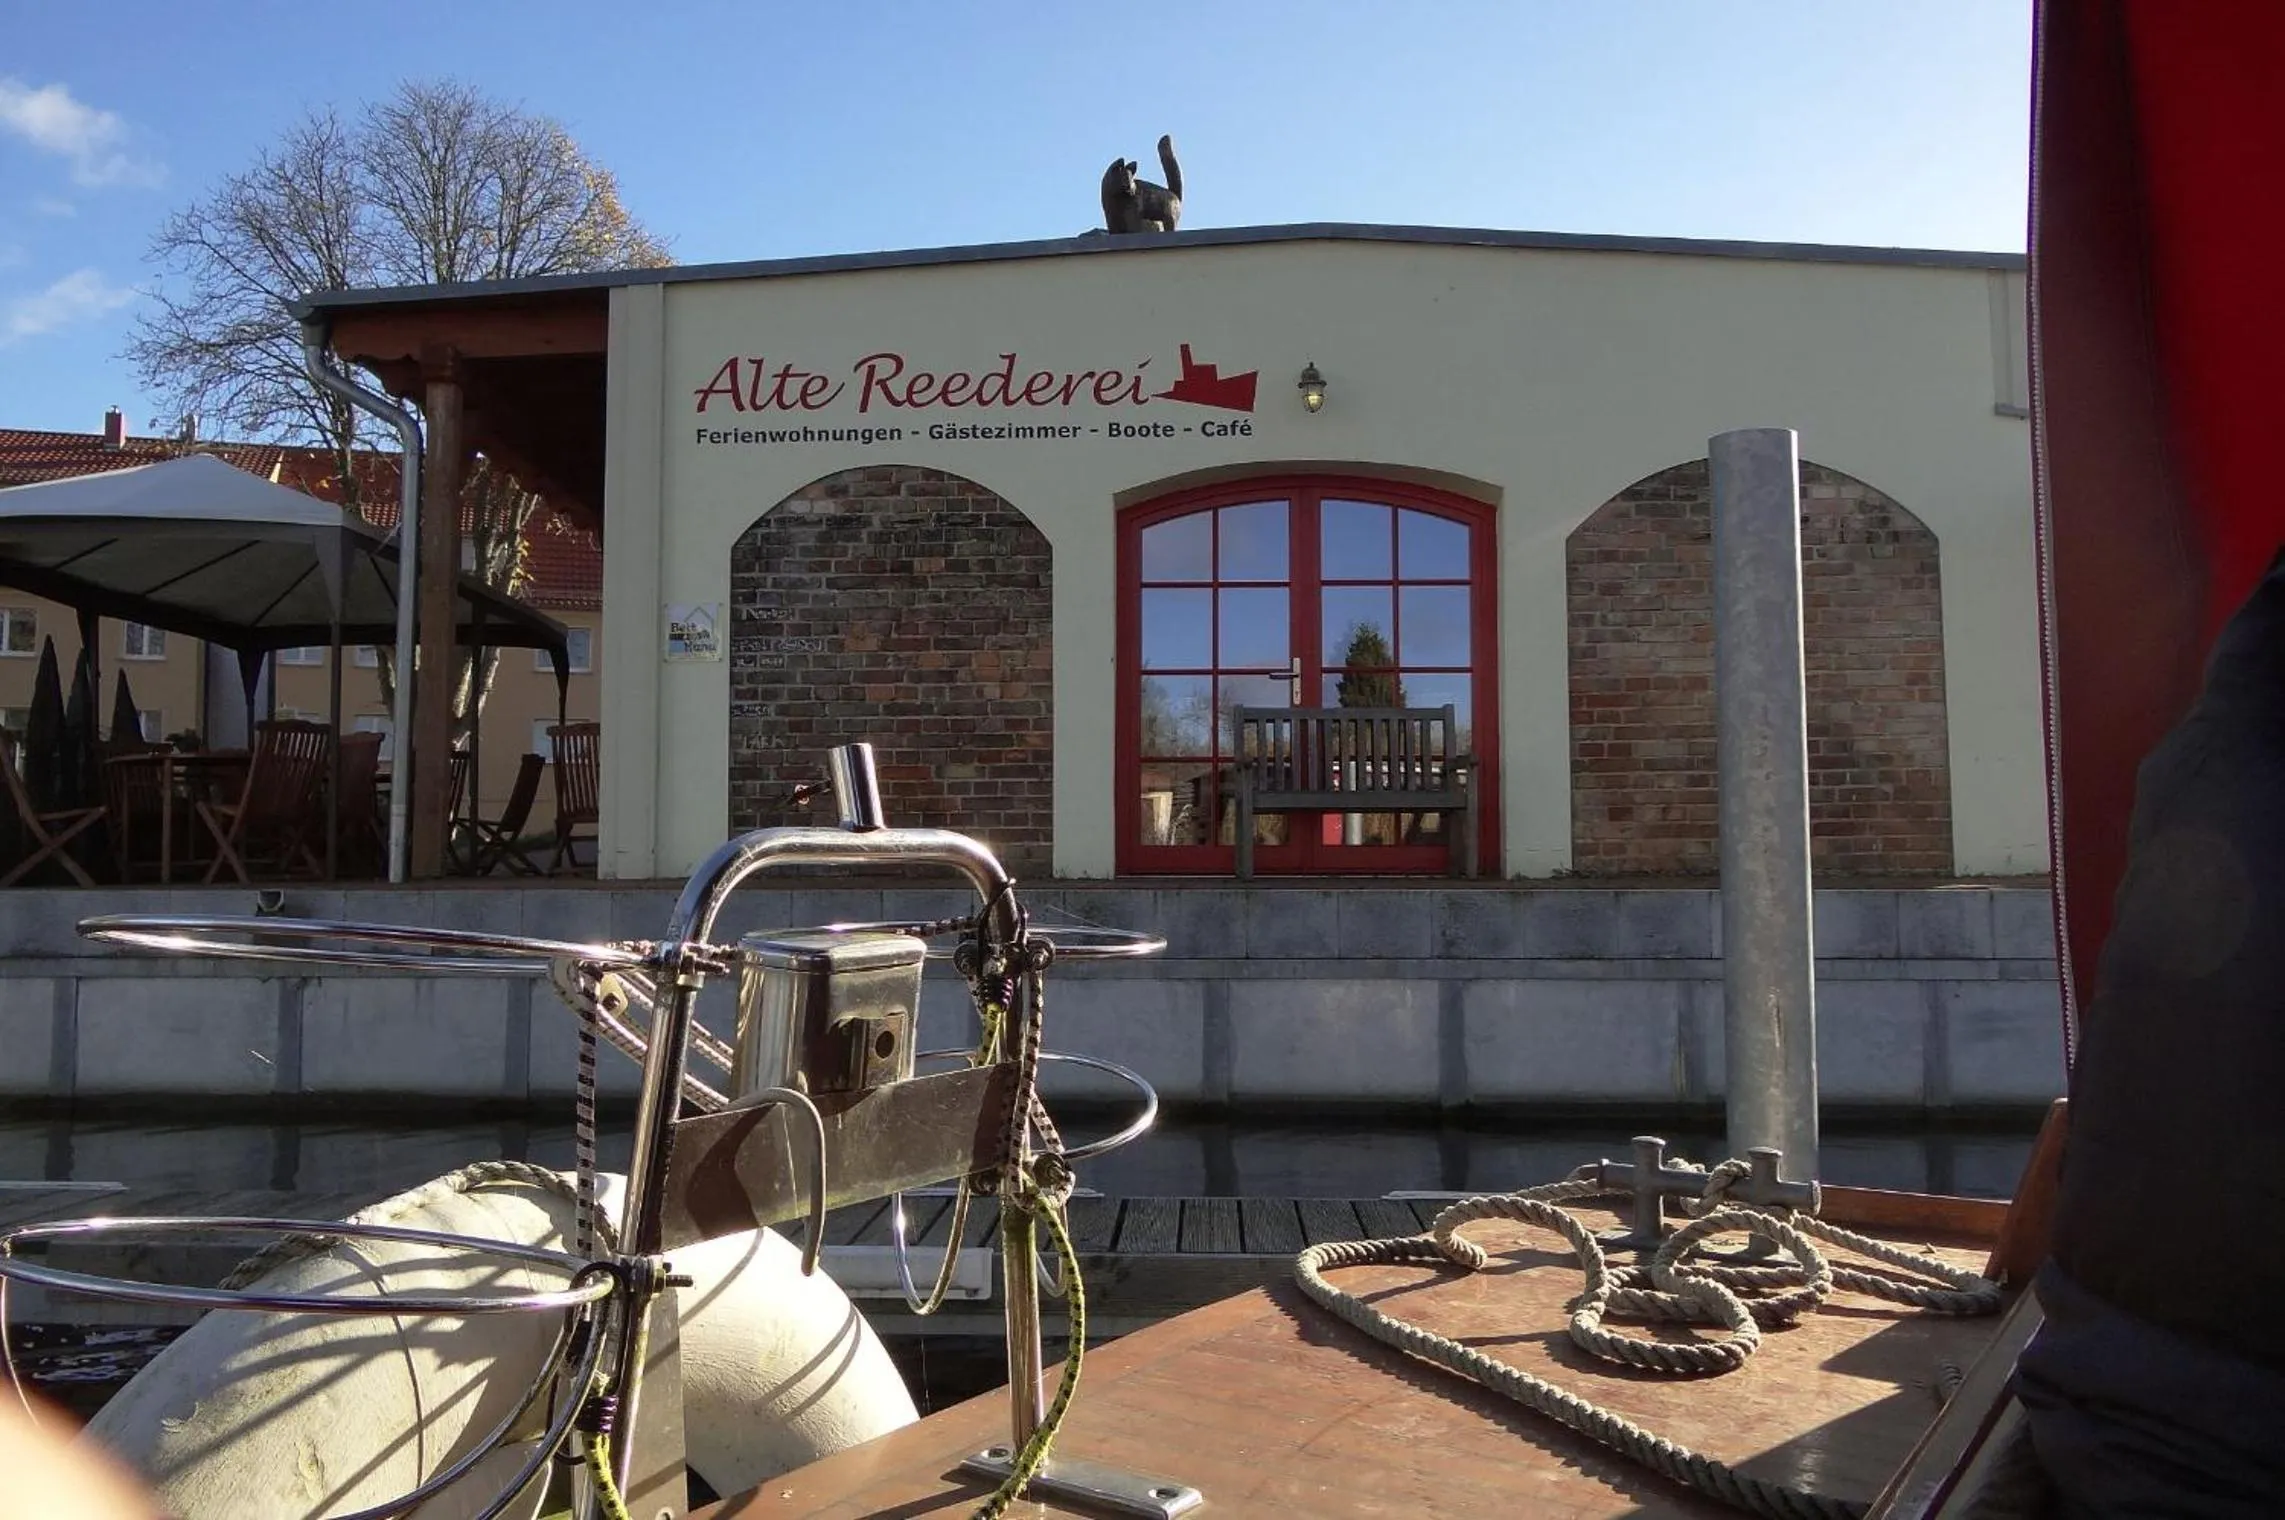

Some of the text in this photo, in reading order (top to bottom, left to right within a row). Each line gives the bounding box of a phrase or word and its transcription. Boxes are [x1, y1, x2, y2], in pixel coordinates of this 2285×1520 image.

[694, 353, 1153, 413] Alte Reederei
[696, 426, 902, 445] Ferienwohnungen
[929, 423, 1082, 440] Gästezimmer
[1108, 422, 1175, 437] Boote
[1201, 412, 1254, 437] Café
